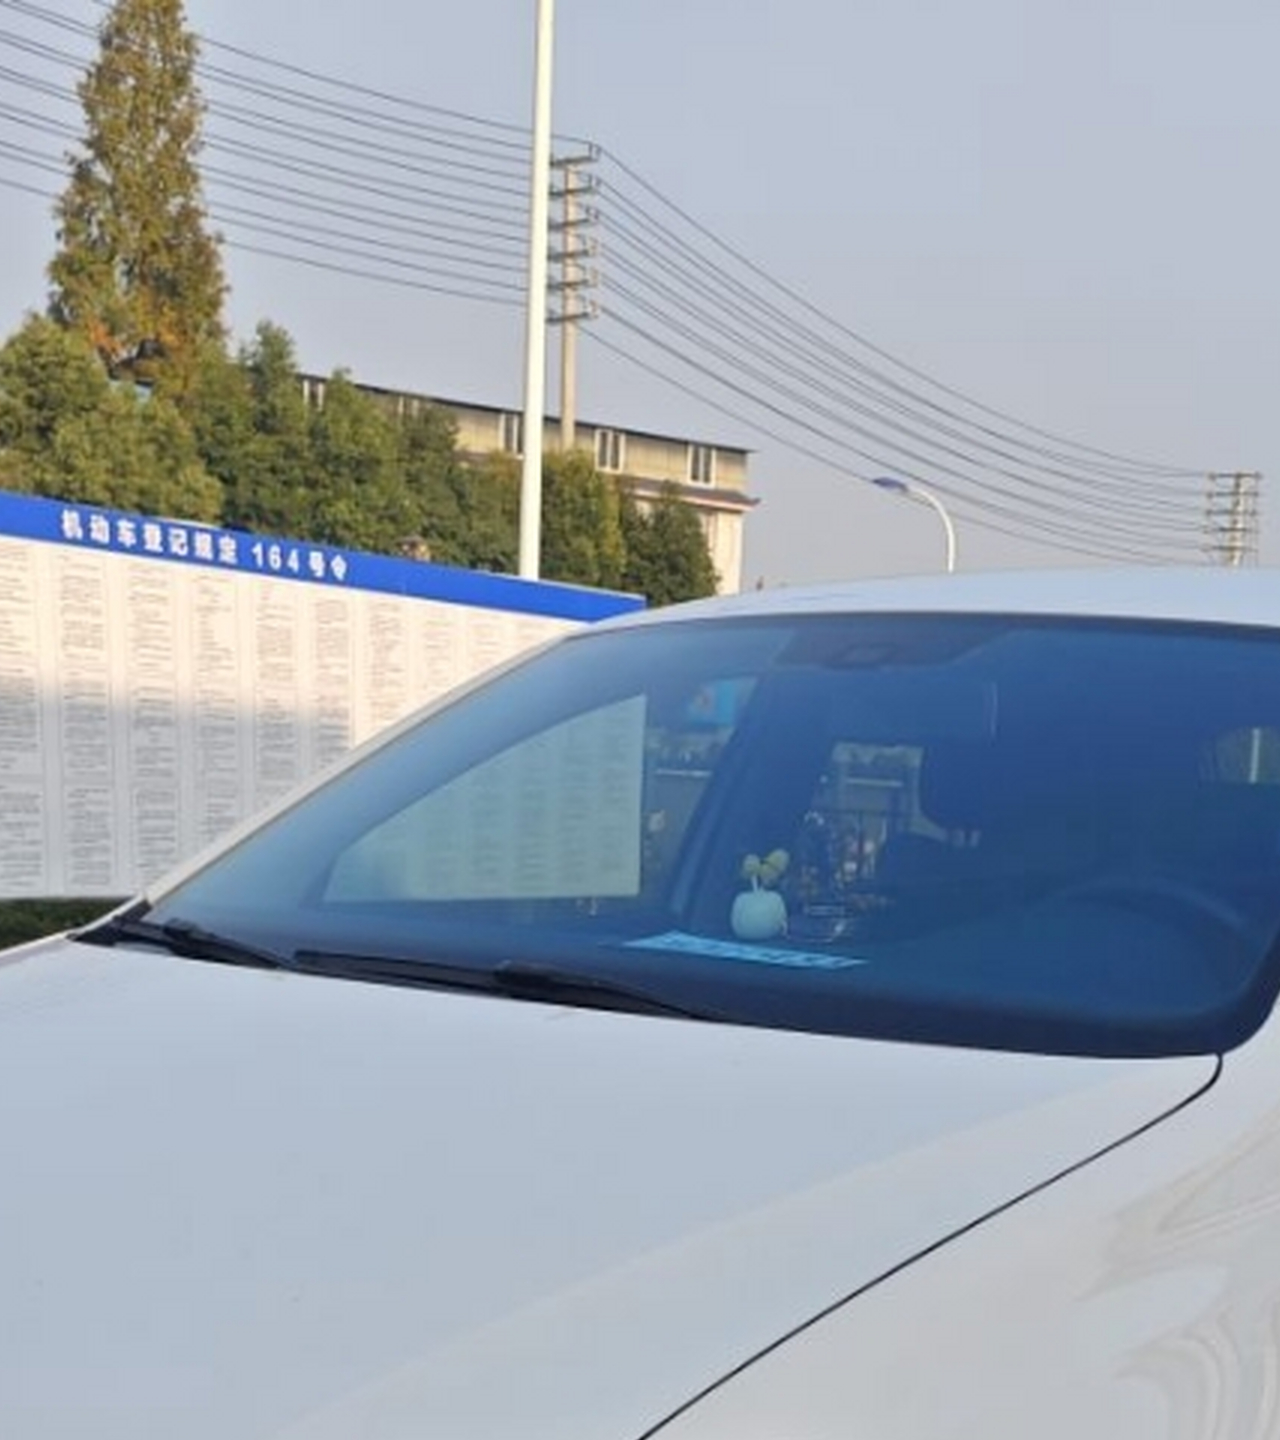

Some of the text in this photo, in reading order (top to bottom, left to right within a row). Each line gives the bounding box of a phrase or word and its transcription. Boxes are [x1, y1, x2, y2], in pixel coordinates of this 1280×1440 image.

[60, 509, 238, 564] 机动车登记规定
